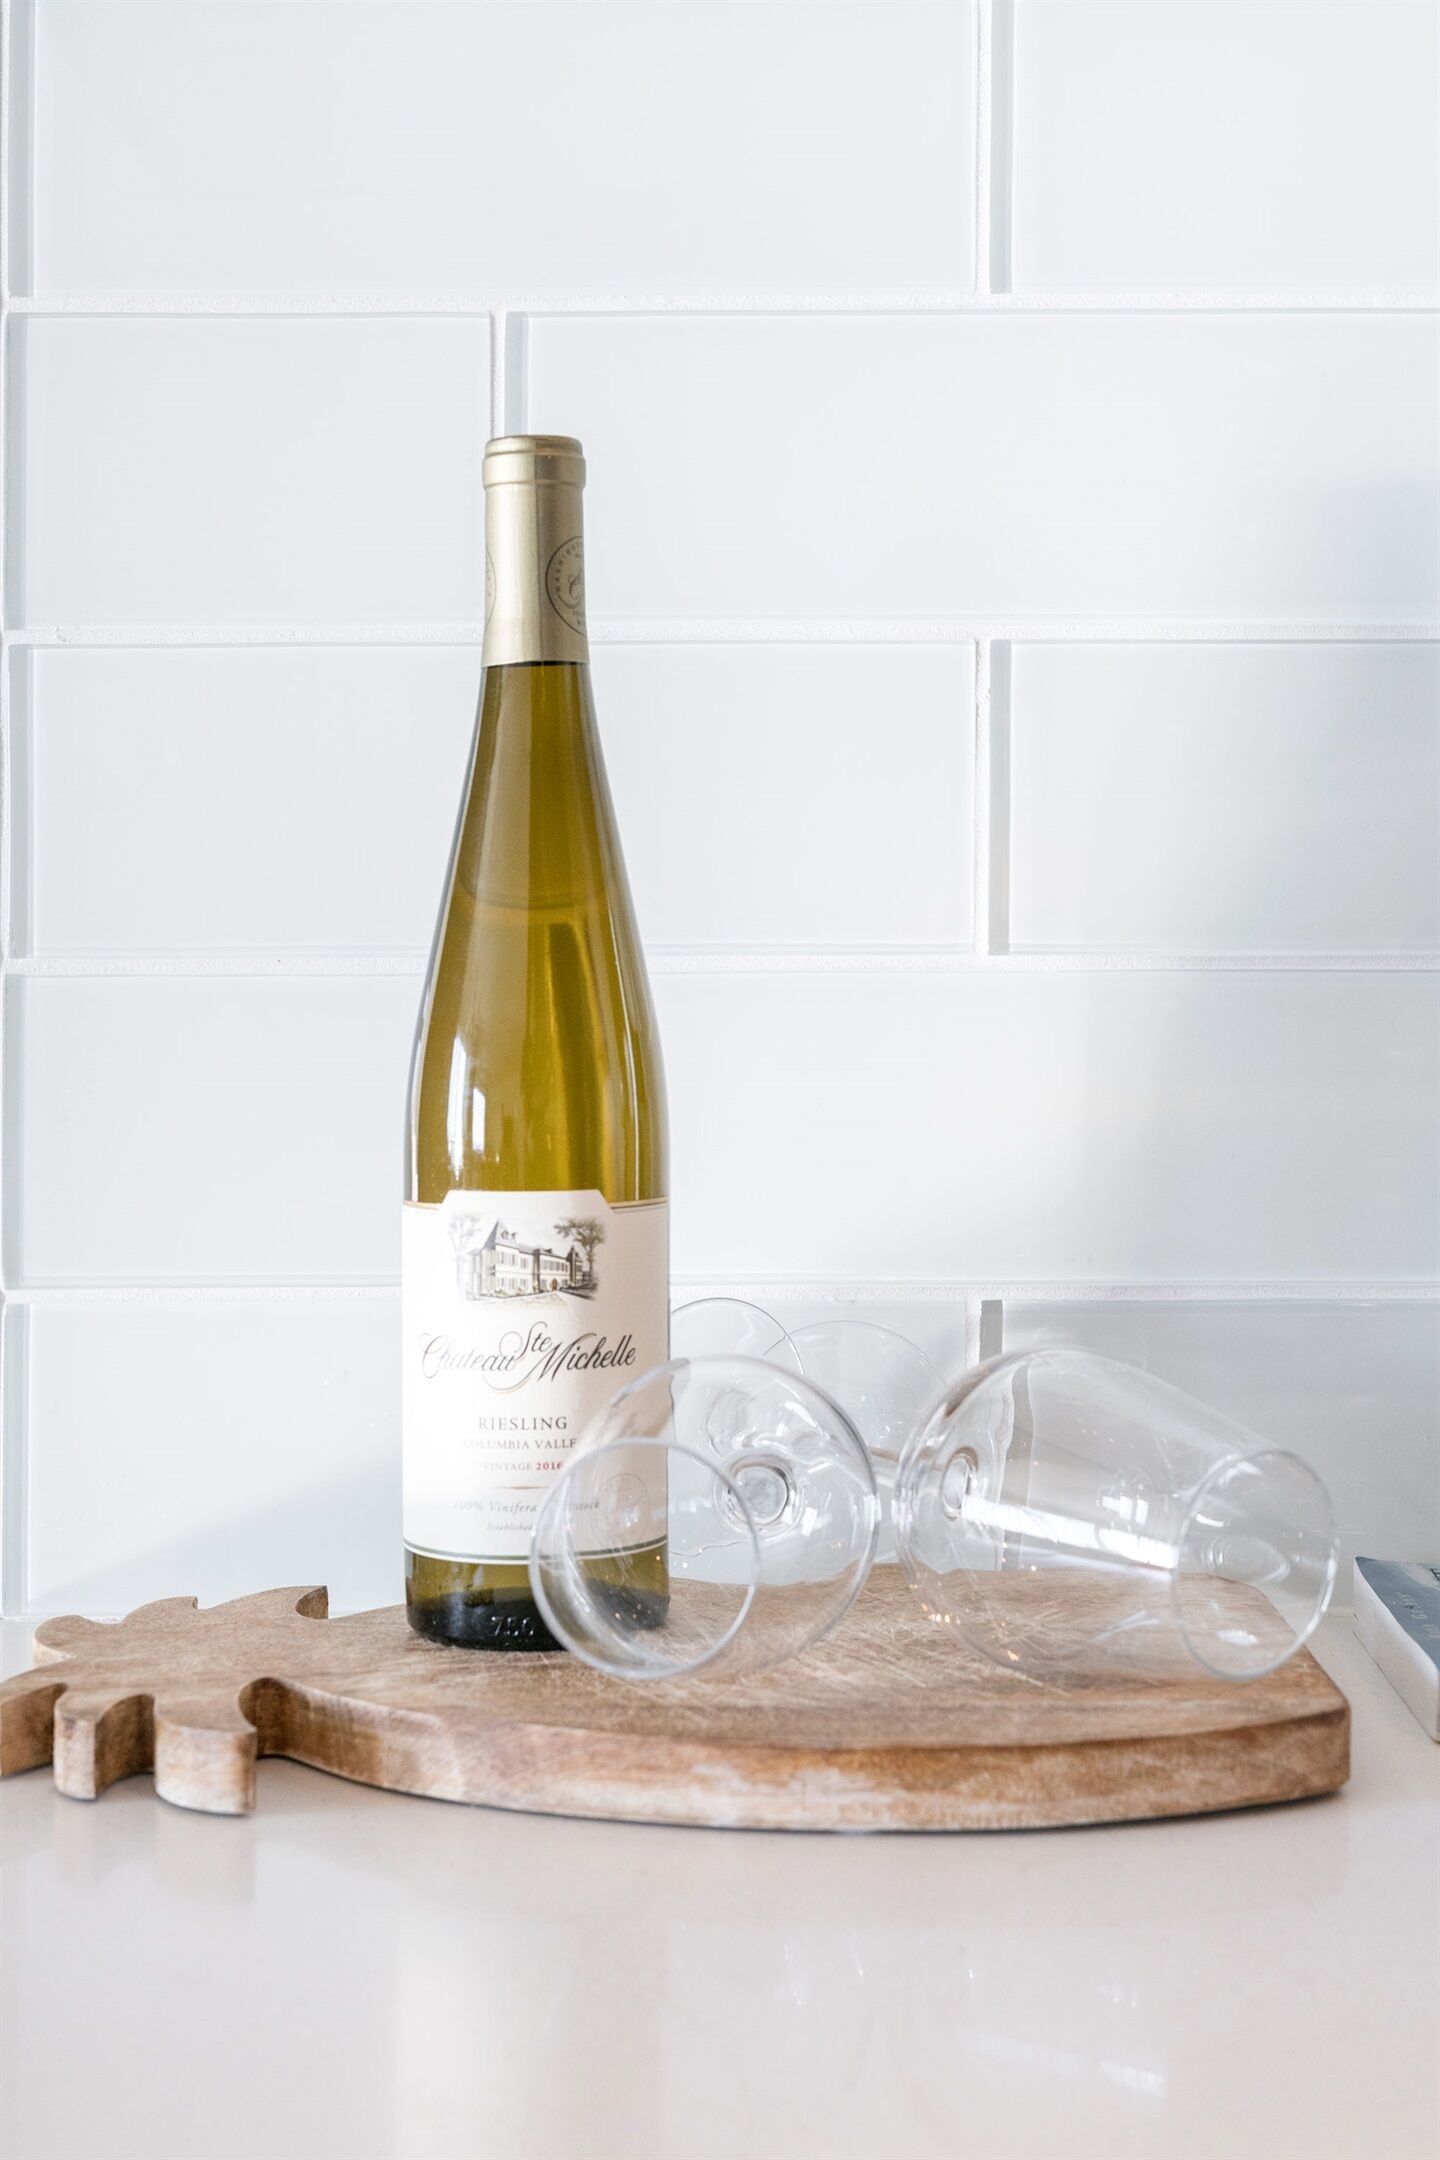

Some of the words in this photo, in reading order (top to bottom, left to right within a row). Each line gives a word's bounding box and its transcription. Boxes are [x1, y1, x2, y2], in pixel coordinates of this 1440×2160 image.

[499, 1321, 553, 1358] Ste
[420, 1332, 518, 1379] Chateau
[484, 1332, 637, 1392] Michelle
[478, 1415, 568, 1431] RIESLING
[462, 1438, 530, 1450] COLUMBIA
[535, 1438, 577, 1449] VALLE
[483, 1462, 533, 1472] VINTAGE
[535, 1461, 563, 1471] 2016
[489, 1501, 538, 1516] Vinifera
